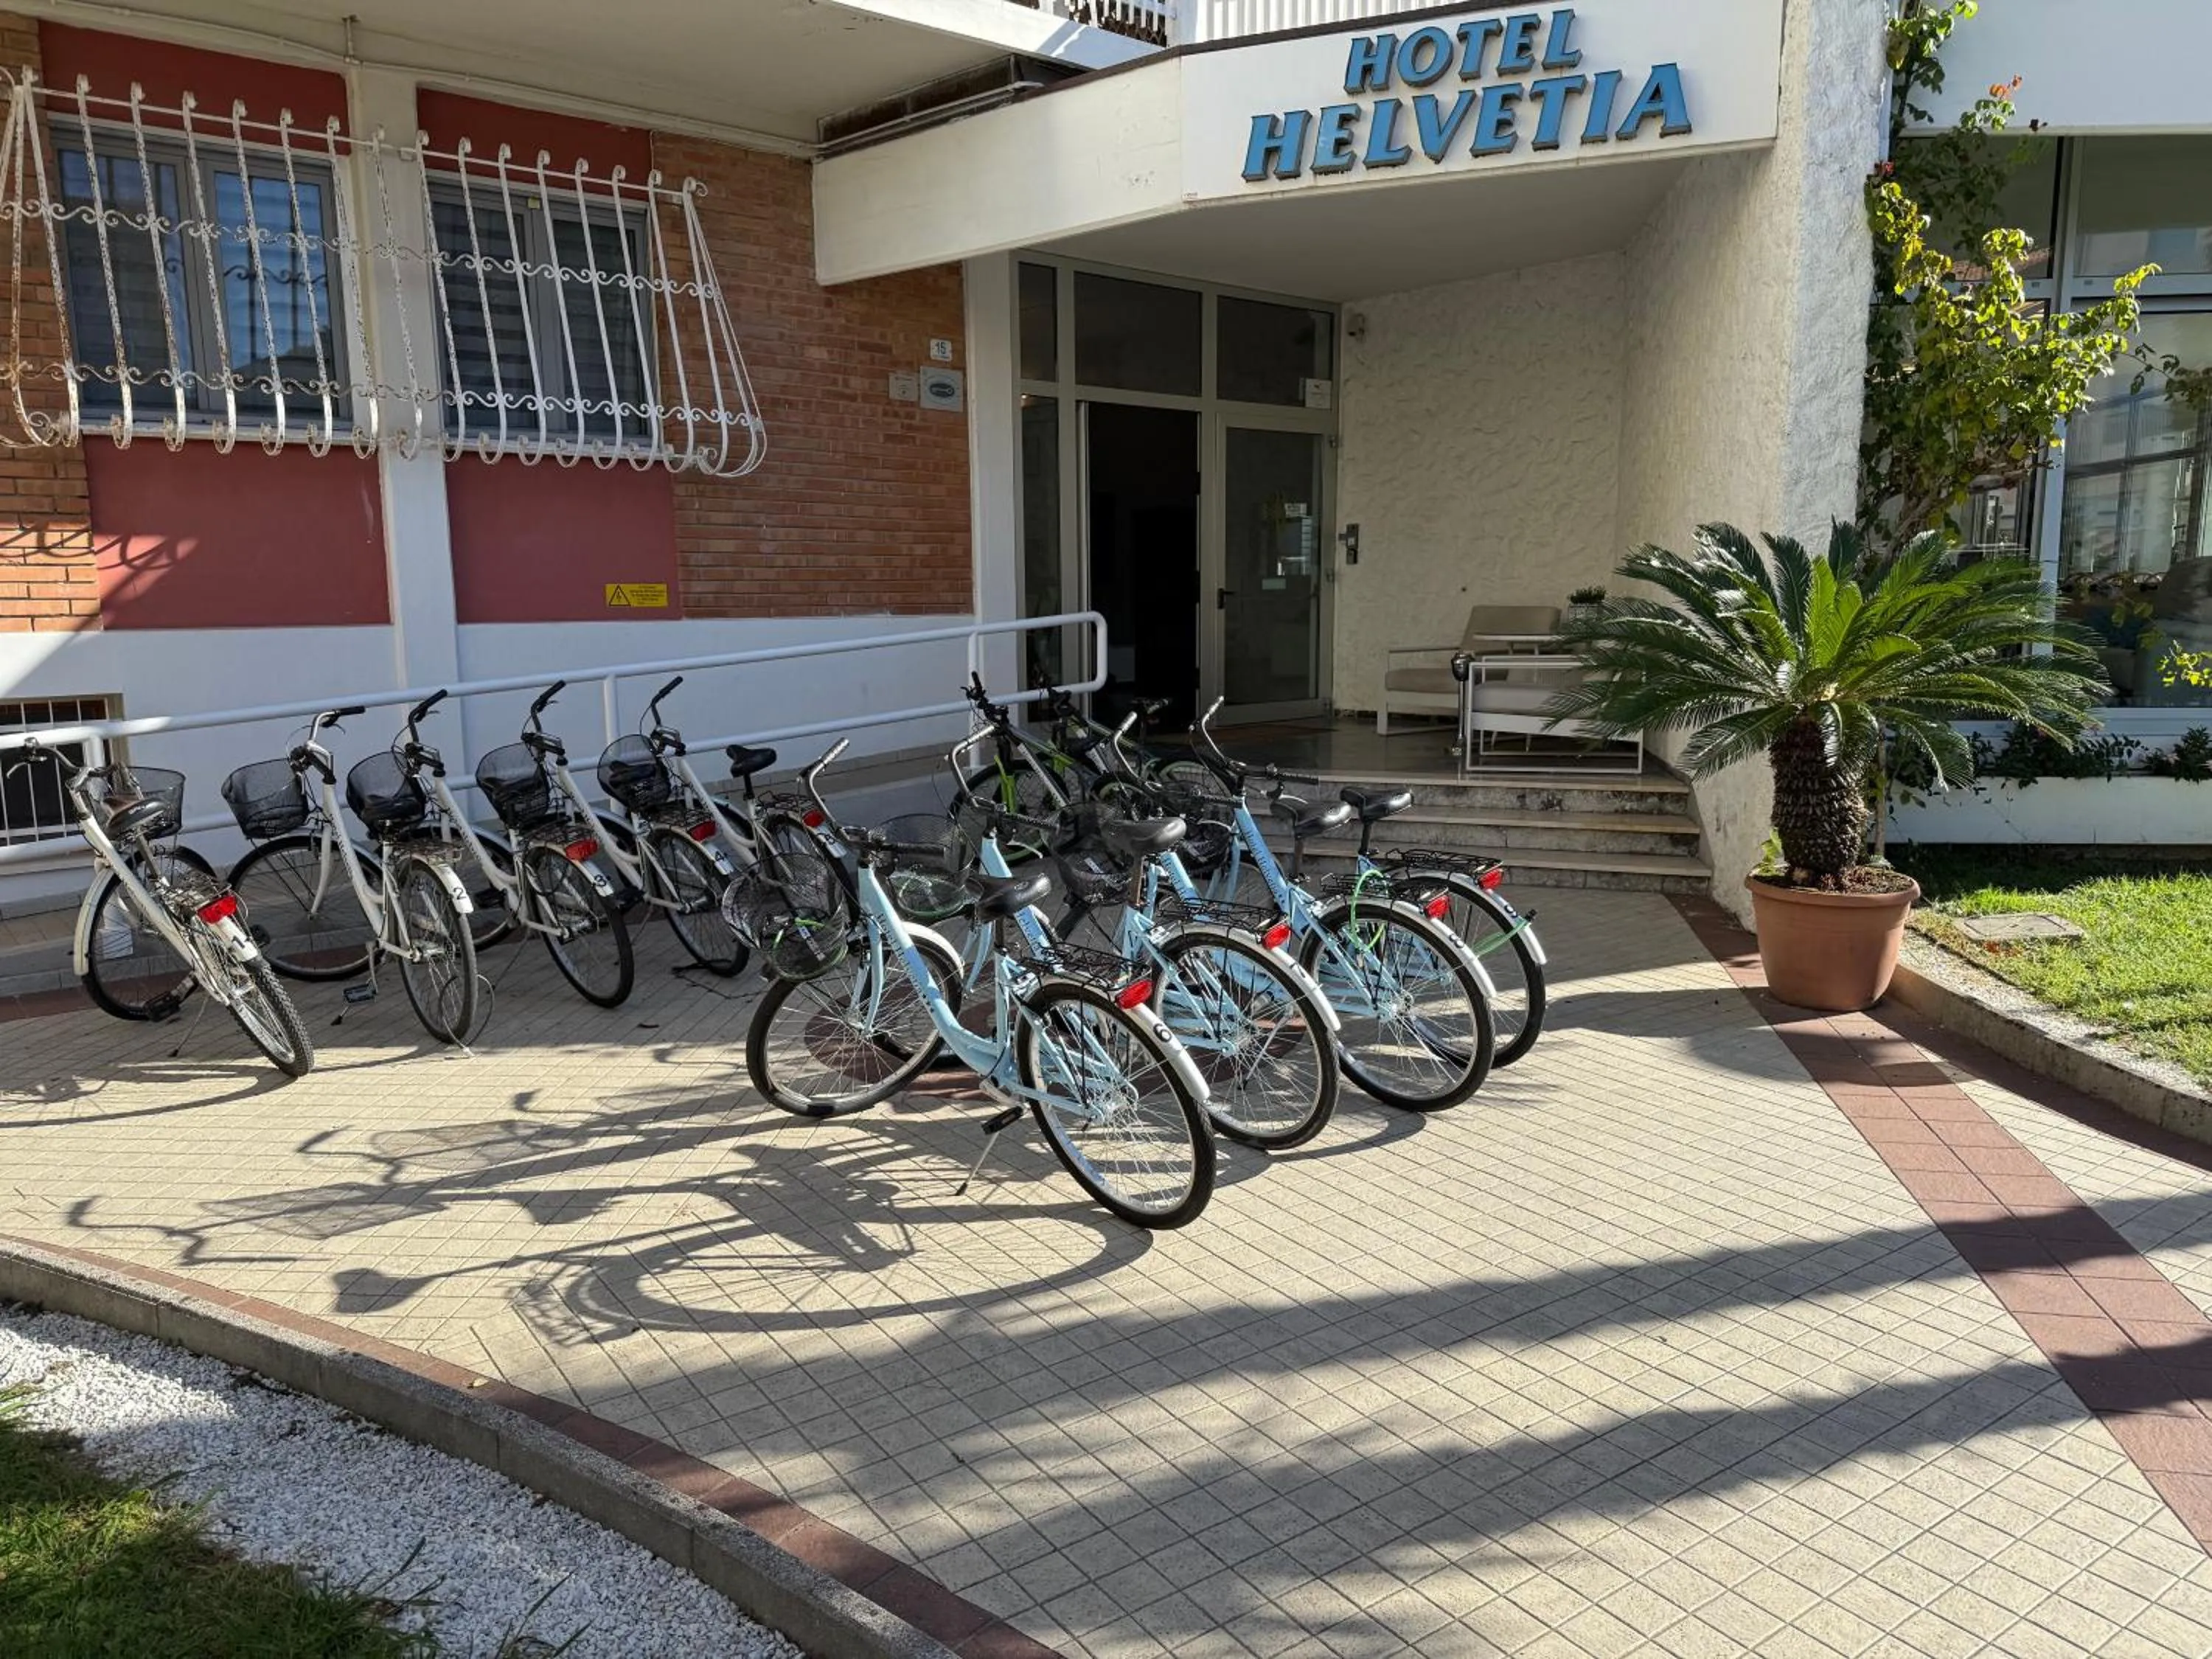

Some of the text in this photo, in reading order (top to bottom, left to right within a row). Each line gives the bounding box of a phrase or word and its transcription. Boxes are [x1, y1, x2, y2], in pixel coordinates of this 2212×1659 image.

[1344, 8, 1583, 95] HOTEL
[1241, 62, 1693, 181] HELVETIA
[935, 341, 947, 355] 15
[714, 851, 725, 862] 4
[594, 874, 607, 886] 3
[453, 887, 466, 900] 2
[1504, 903, 1518, 918] 9
[232, 936, 245, 949] 1
[1449, 933, 1464, 949] 8
[1290, 961, 1306, 978] 7
[1153, 1023, 1172, 1043] 6
